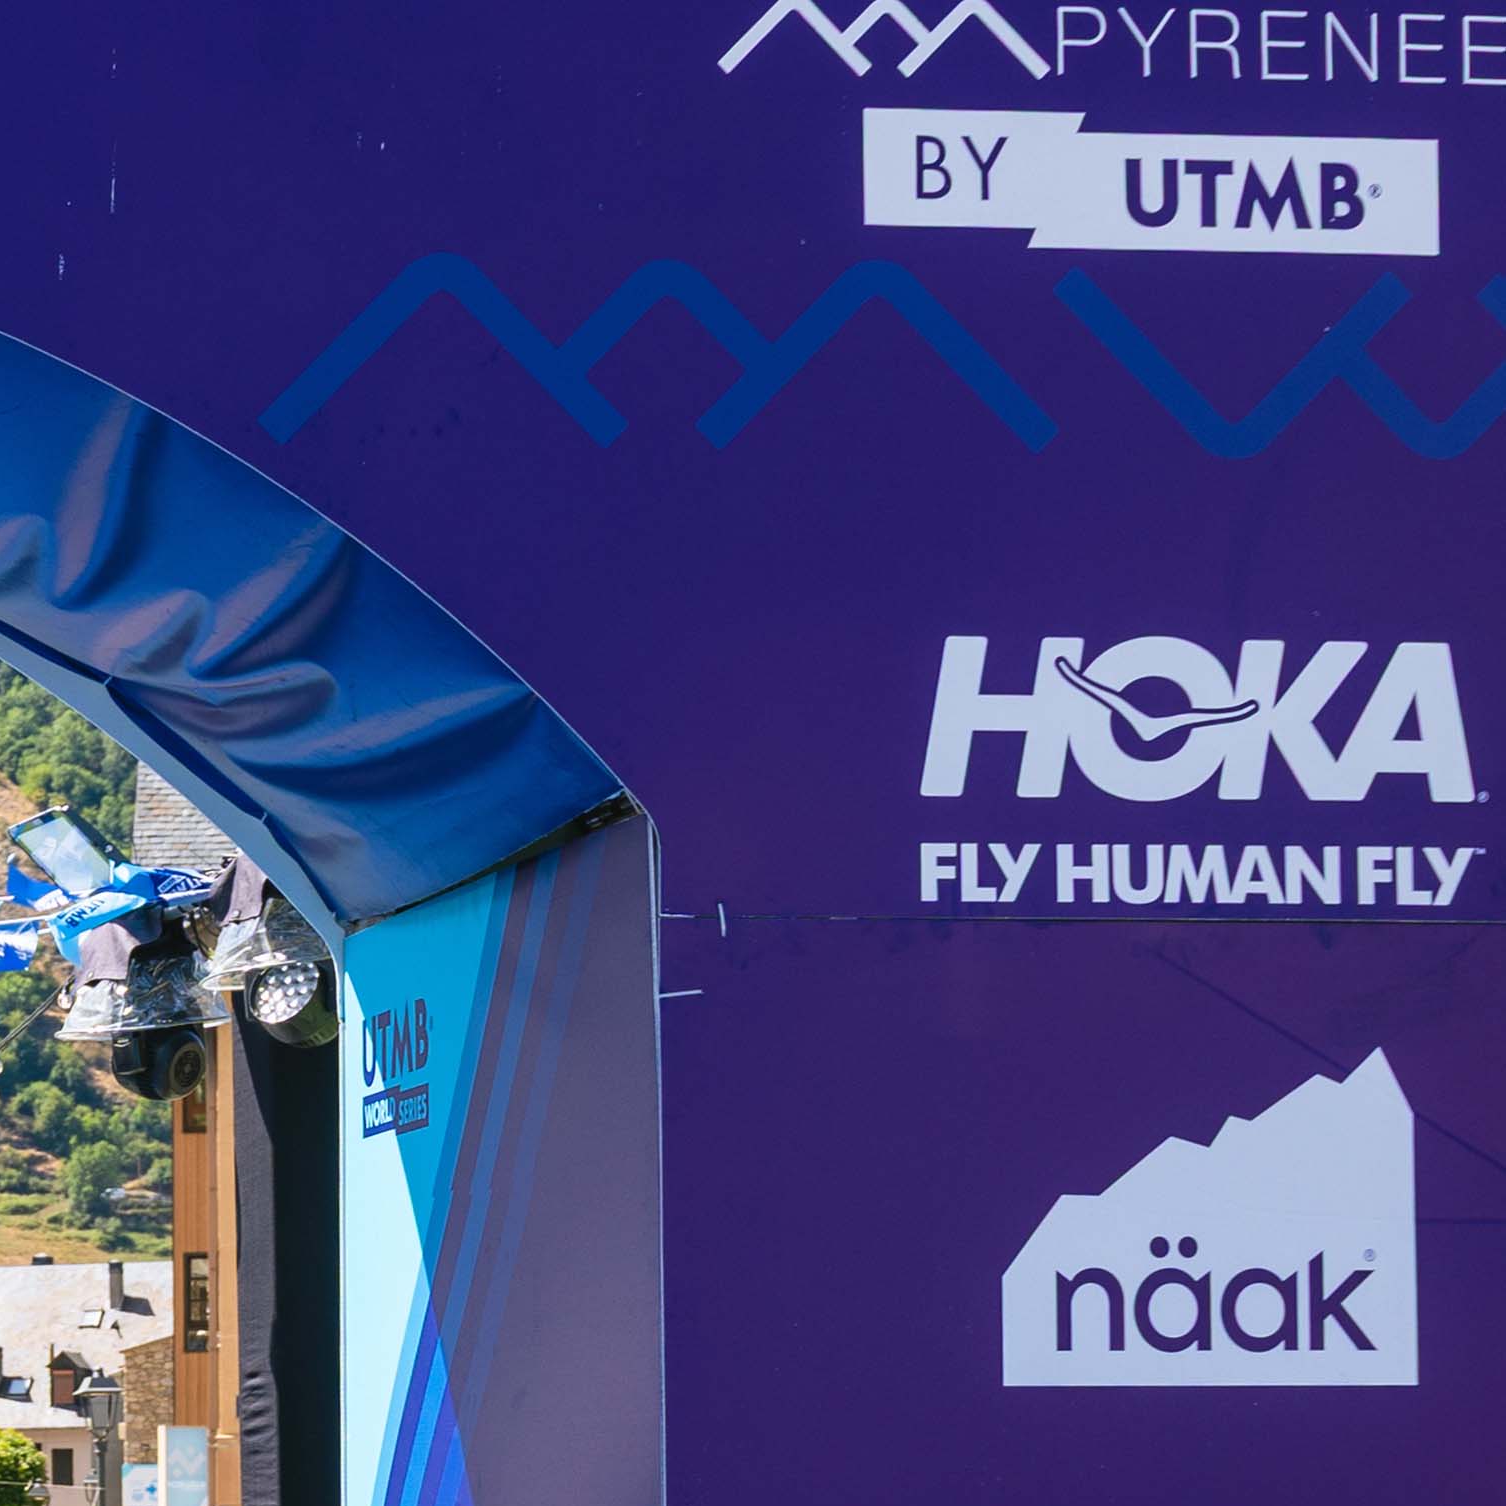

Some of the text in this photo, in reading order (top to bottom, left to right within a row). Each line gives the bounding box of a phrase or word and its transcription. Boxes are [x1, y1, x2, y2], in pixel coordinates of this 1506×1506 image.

[915, 135, 1365, 231] BY UTMB
[920, 635, 1475, 802] HOKA
[920, 843, 1474, 905] FLY HUMAN FLY
[363, 998, 429, 1087] UTMB
[364, 1094, 427, 1129] WORLD SERIES
[1055, 1236, 1378, 1353] näak
